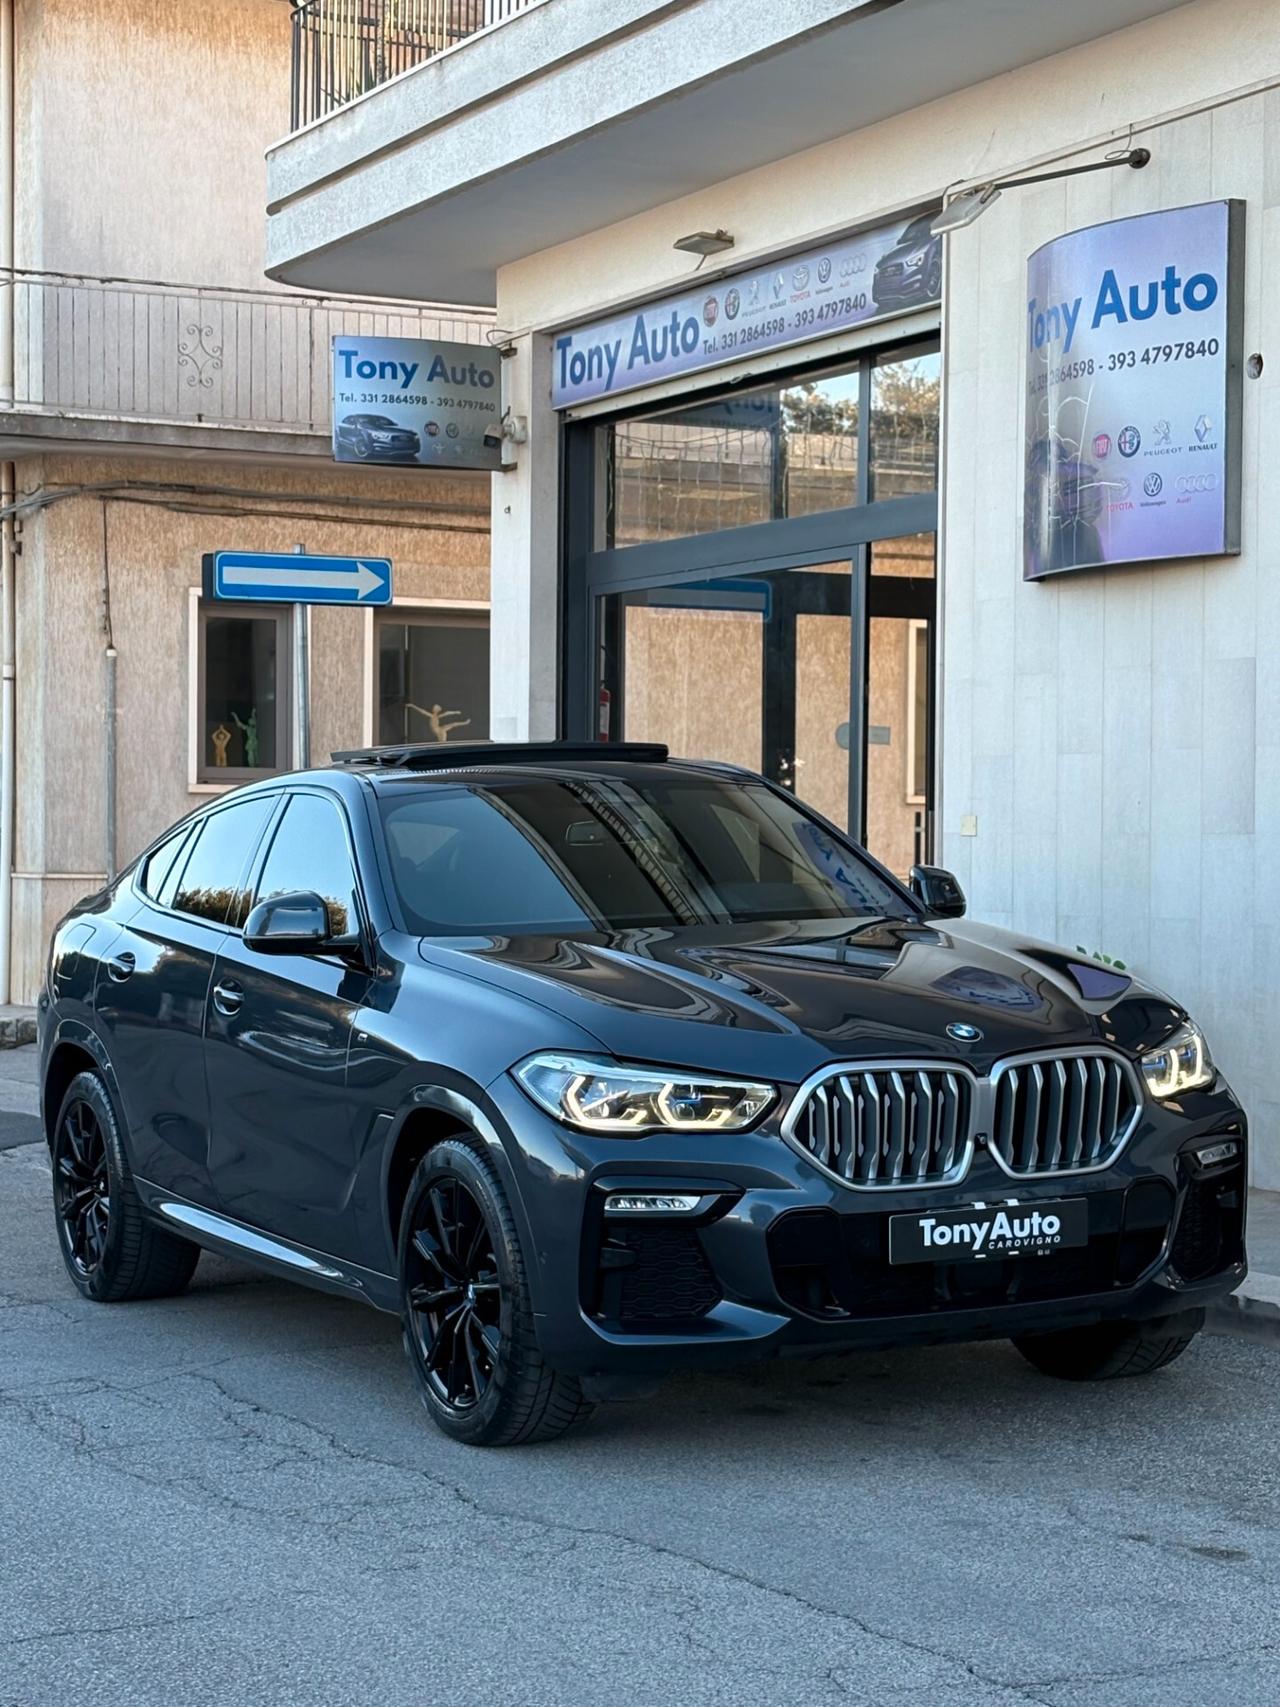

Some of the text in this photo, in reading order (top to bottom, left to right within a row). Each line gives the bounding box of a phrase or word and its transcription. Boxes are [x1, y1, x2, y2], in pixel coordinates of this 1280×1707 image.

[703, 340, 719, 355] Tel.
[721, 331, 738, 348] 331
[740, 317, 785, 344] 2864598
[795, 310, 815, 329] 393
[817, 293, 866, 320] 4797840
[1027, 265, 1218, 354] Tony Auto
[339, 350, 495, 389] Tony Auto
[556, 336, 622, 392] Tony
[627, 310, 699, 370] Auto
[1049, 359, 1095, 386] 2864598
[1108, 350, 1136, 371] 393
[1140, 338, 1220, 366] 4797840
[340, 393, 357, 403] Tel.
[360, 393, 378, 403] 331
[381, 394, 428, 405] 2864598
[437, 397, 454, 408] 393
[456, 400, 496, 412] 4797840
[1144, 443, 1218, 457] PEUGEOT RENAULT
[1106, 502, 1133, 513] TOYOTA
[988, 1235, 1061, 1250] CAROVIGNO
